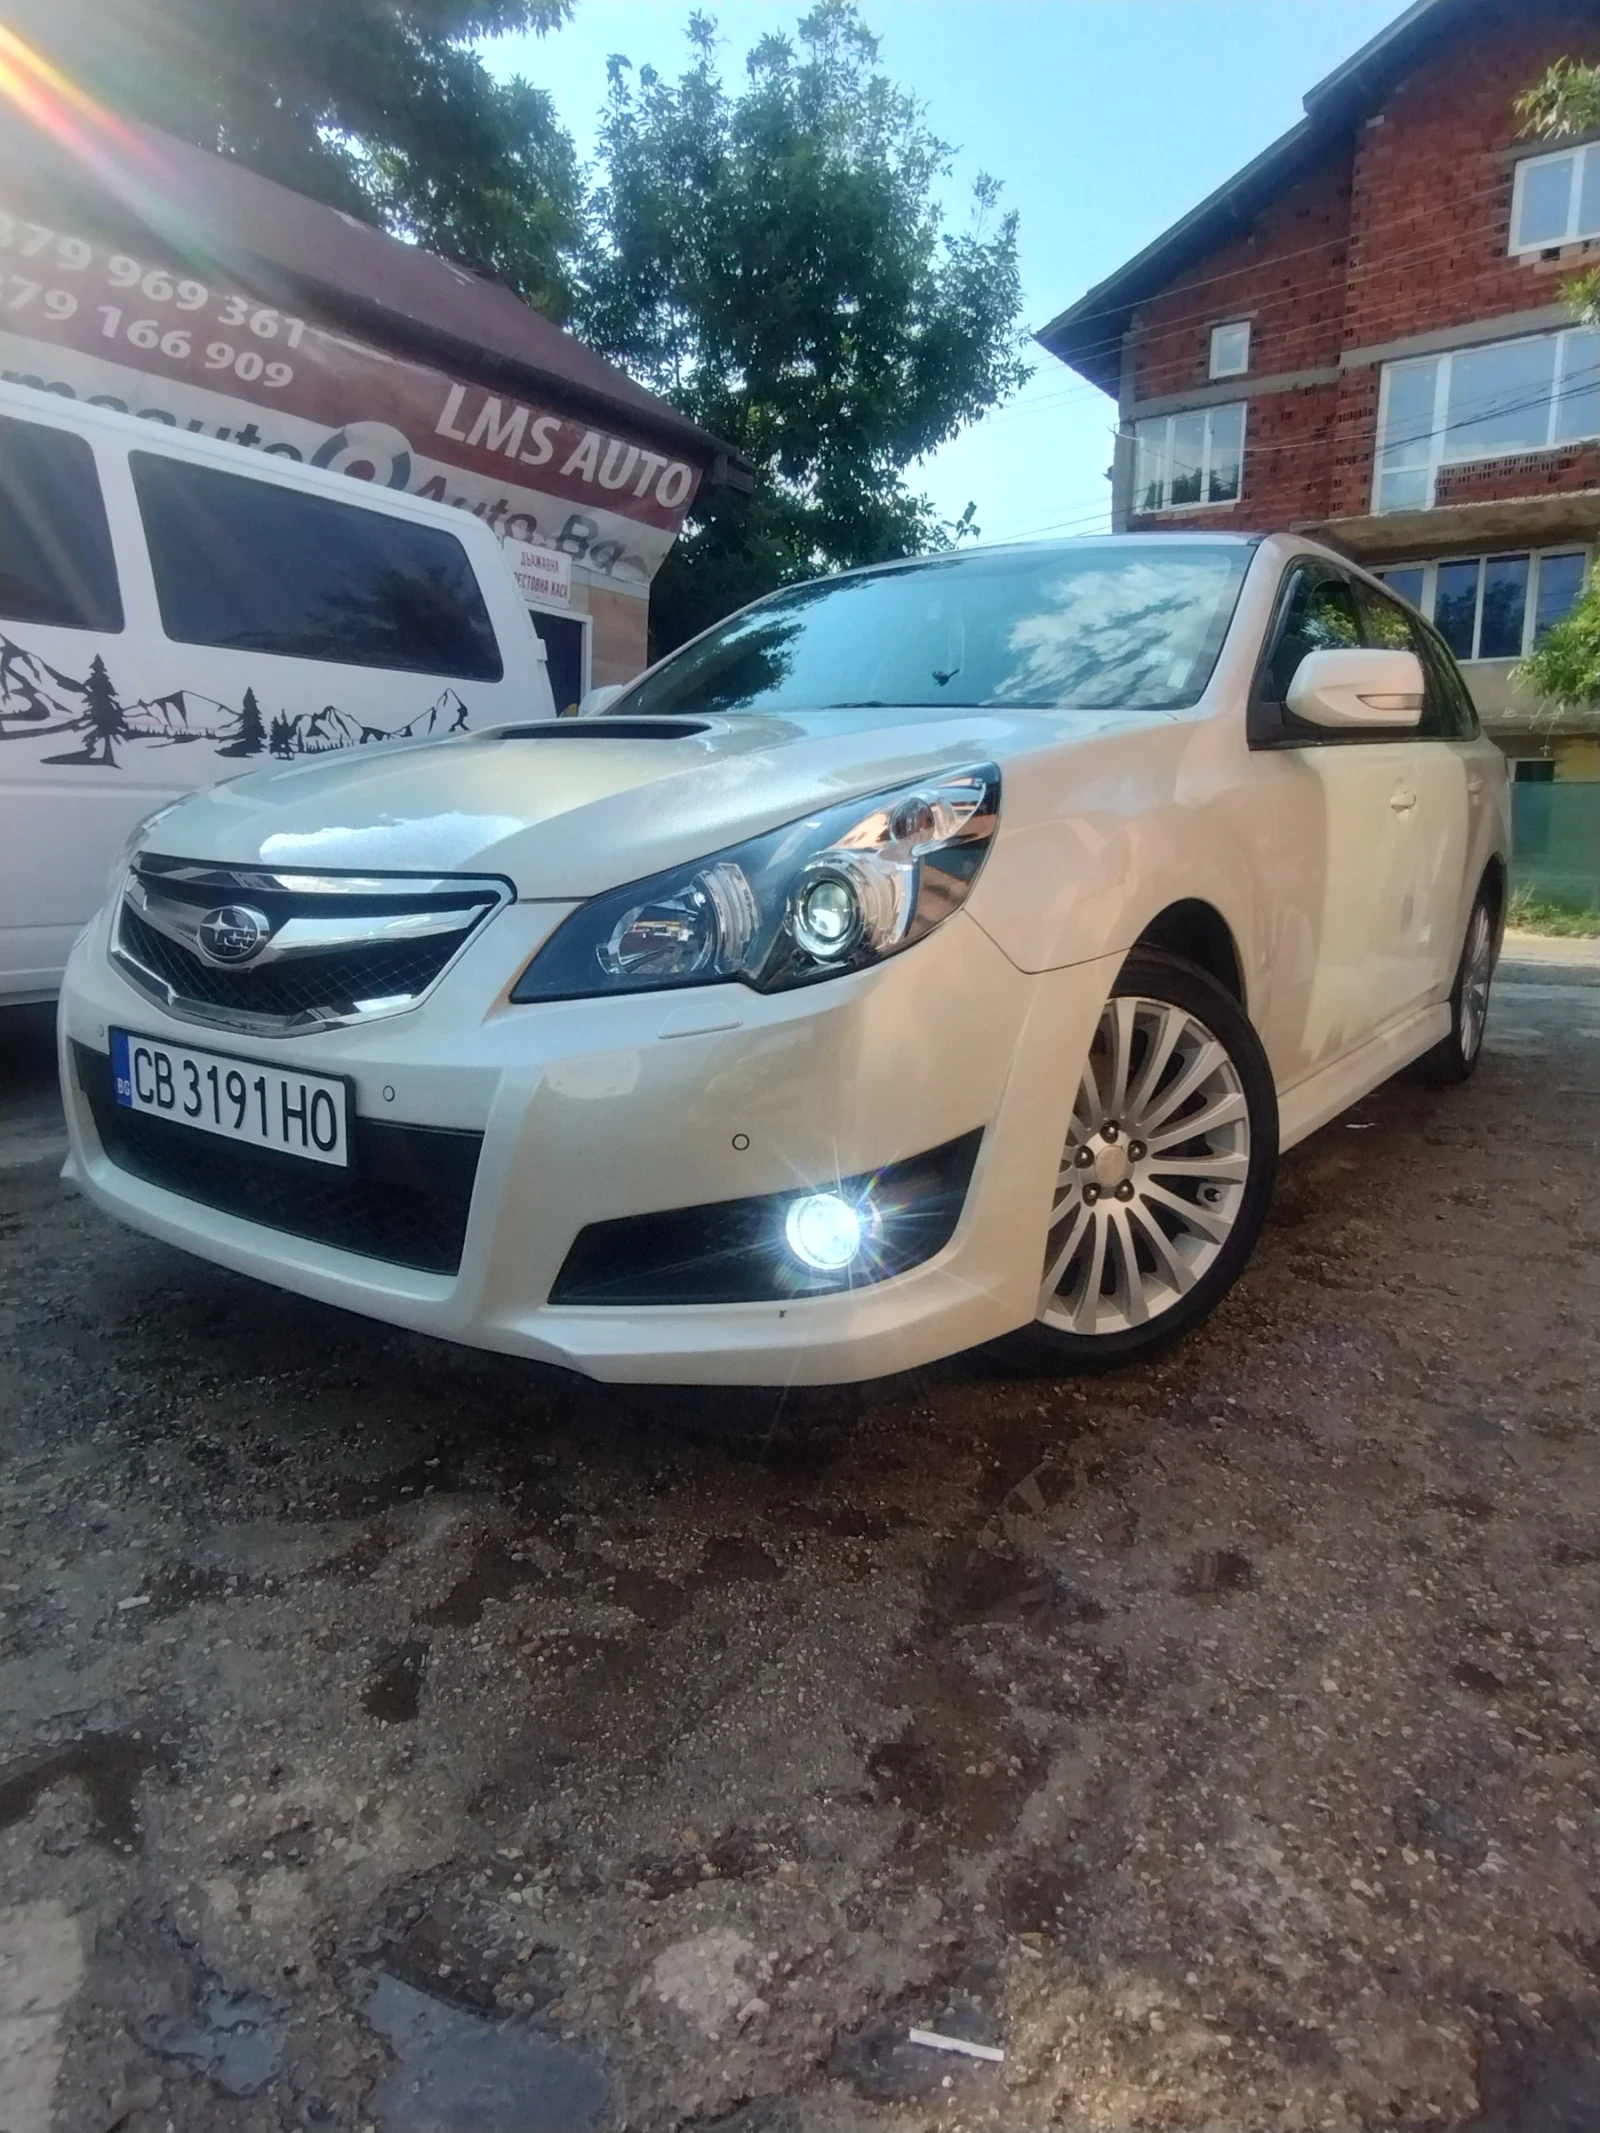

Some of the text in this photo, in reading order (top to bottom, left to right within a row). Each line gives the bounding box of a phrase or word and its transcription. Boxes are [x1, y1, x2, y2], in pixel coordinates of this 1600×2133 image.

[0, 274, 294, 388] 79 166 909
[107, 255, 208, 311] 969
[217, 295, 305, 349] 361
[435, 383, 693, 508] LMS AUTO
[116, 1077, 131, 1096] BG
